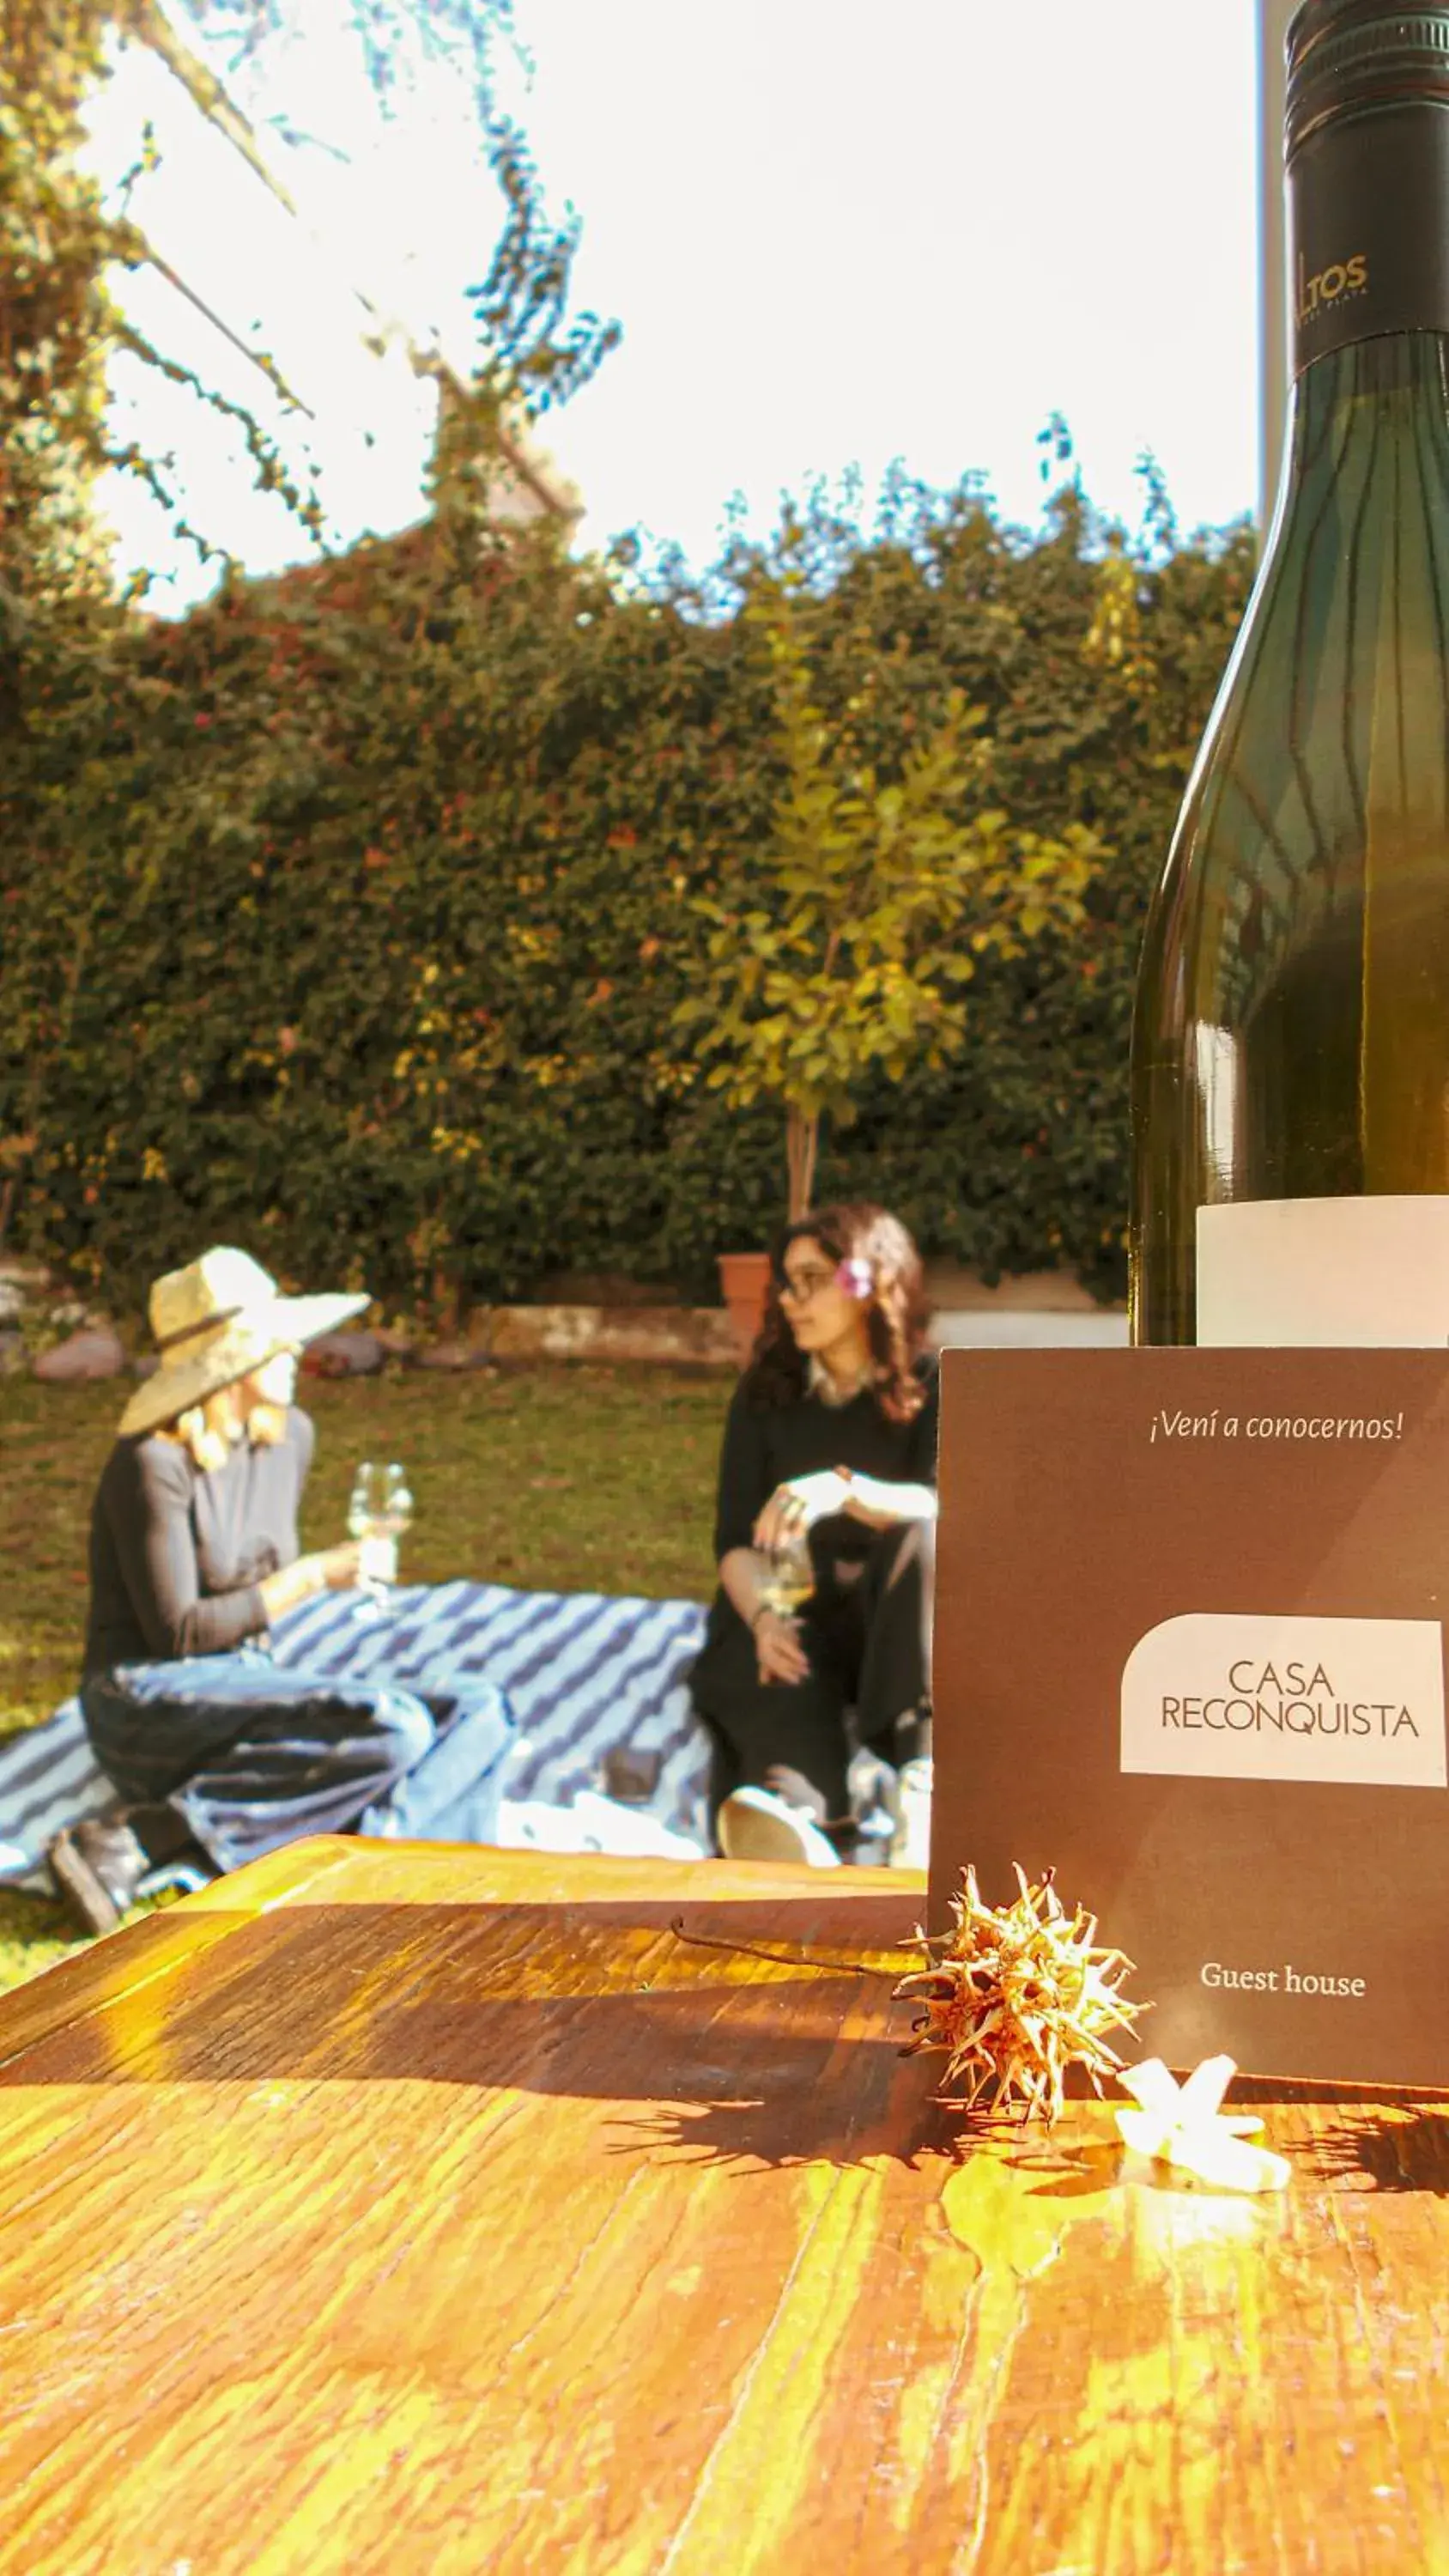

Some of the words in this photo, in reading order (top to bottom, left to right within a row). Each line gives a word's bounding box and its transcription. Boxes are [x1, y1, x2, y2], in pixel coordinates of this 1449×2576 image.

[1149, 1408, 1220, 1443] ¡Vení
[1223, 1416, 1239, 1437] a
[1245, 1412, 1404, 1440] conocernos!
[1228, 1660, 1336, 1698] CASA
[1161, 1696, 1420, 1738] RECONQUISTA
[1201, 1962, 1279, 1992] Guest
[1283, 1965, 1367, 1997] house
